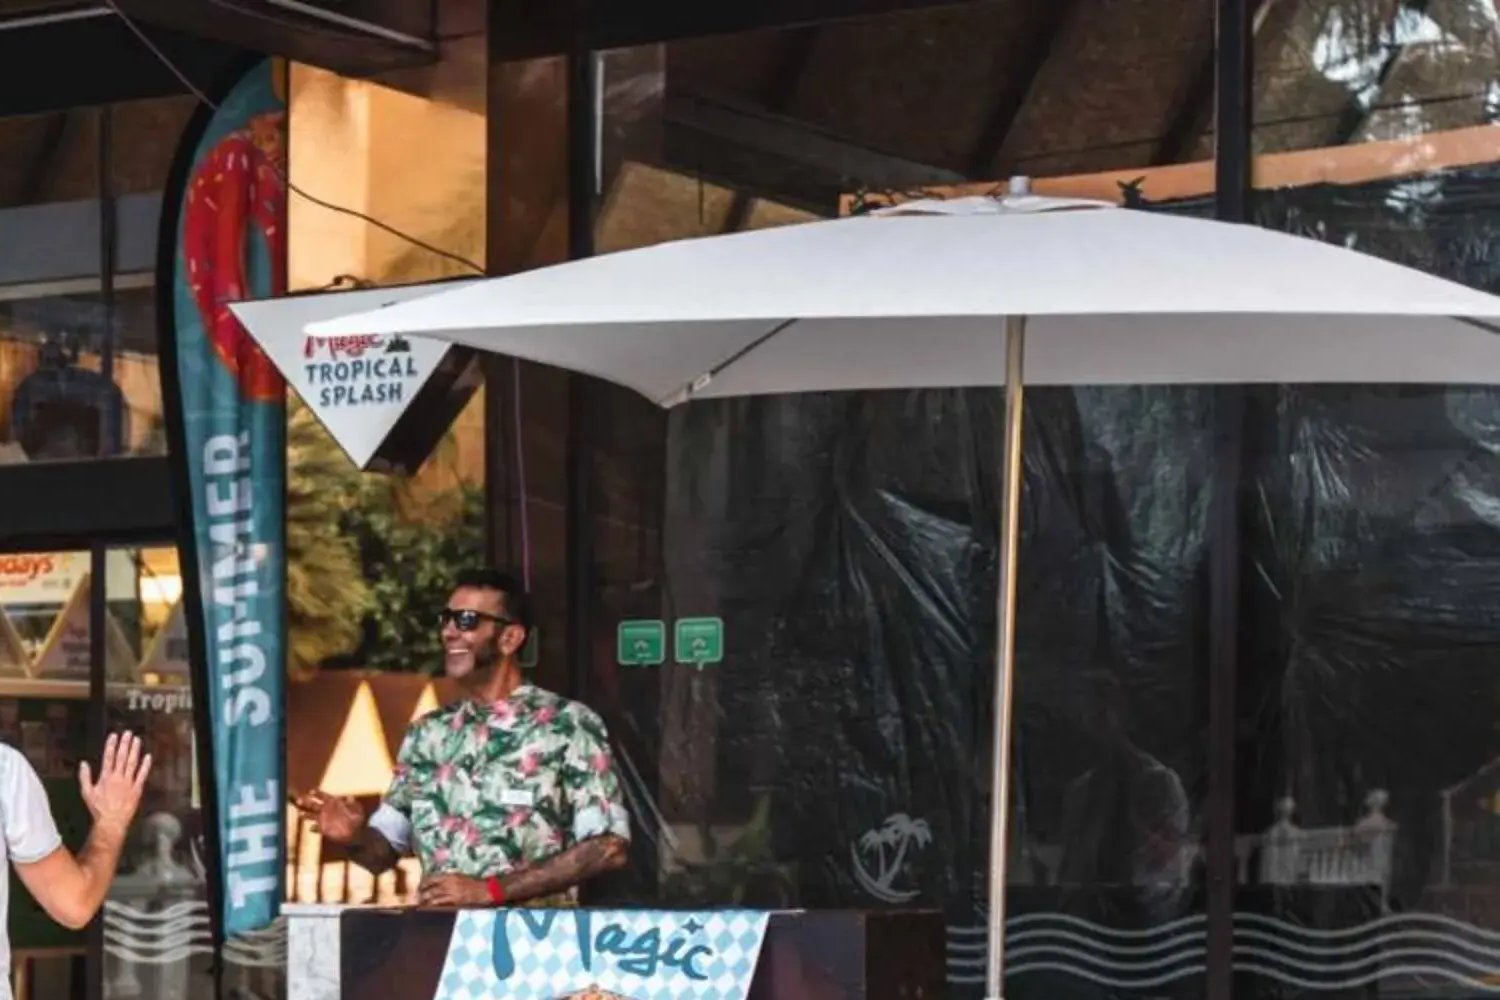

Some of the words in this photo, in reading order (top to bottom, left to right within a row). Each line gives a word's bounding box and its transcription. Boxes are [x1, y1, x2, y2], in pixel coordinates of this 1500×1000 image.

[305, 356, 418, 384] TROPICAL
[320, 381, 403, 407] SPLASH
[203, 430, 271, 727] SUMMER
[228, 778, 278, 909] THE
[492, 909, 713, 981] Magic
